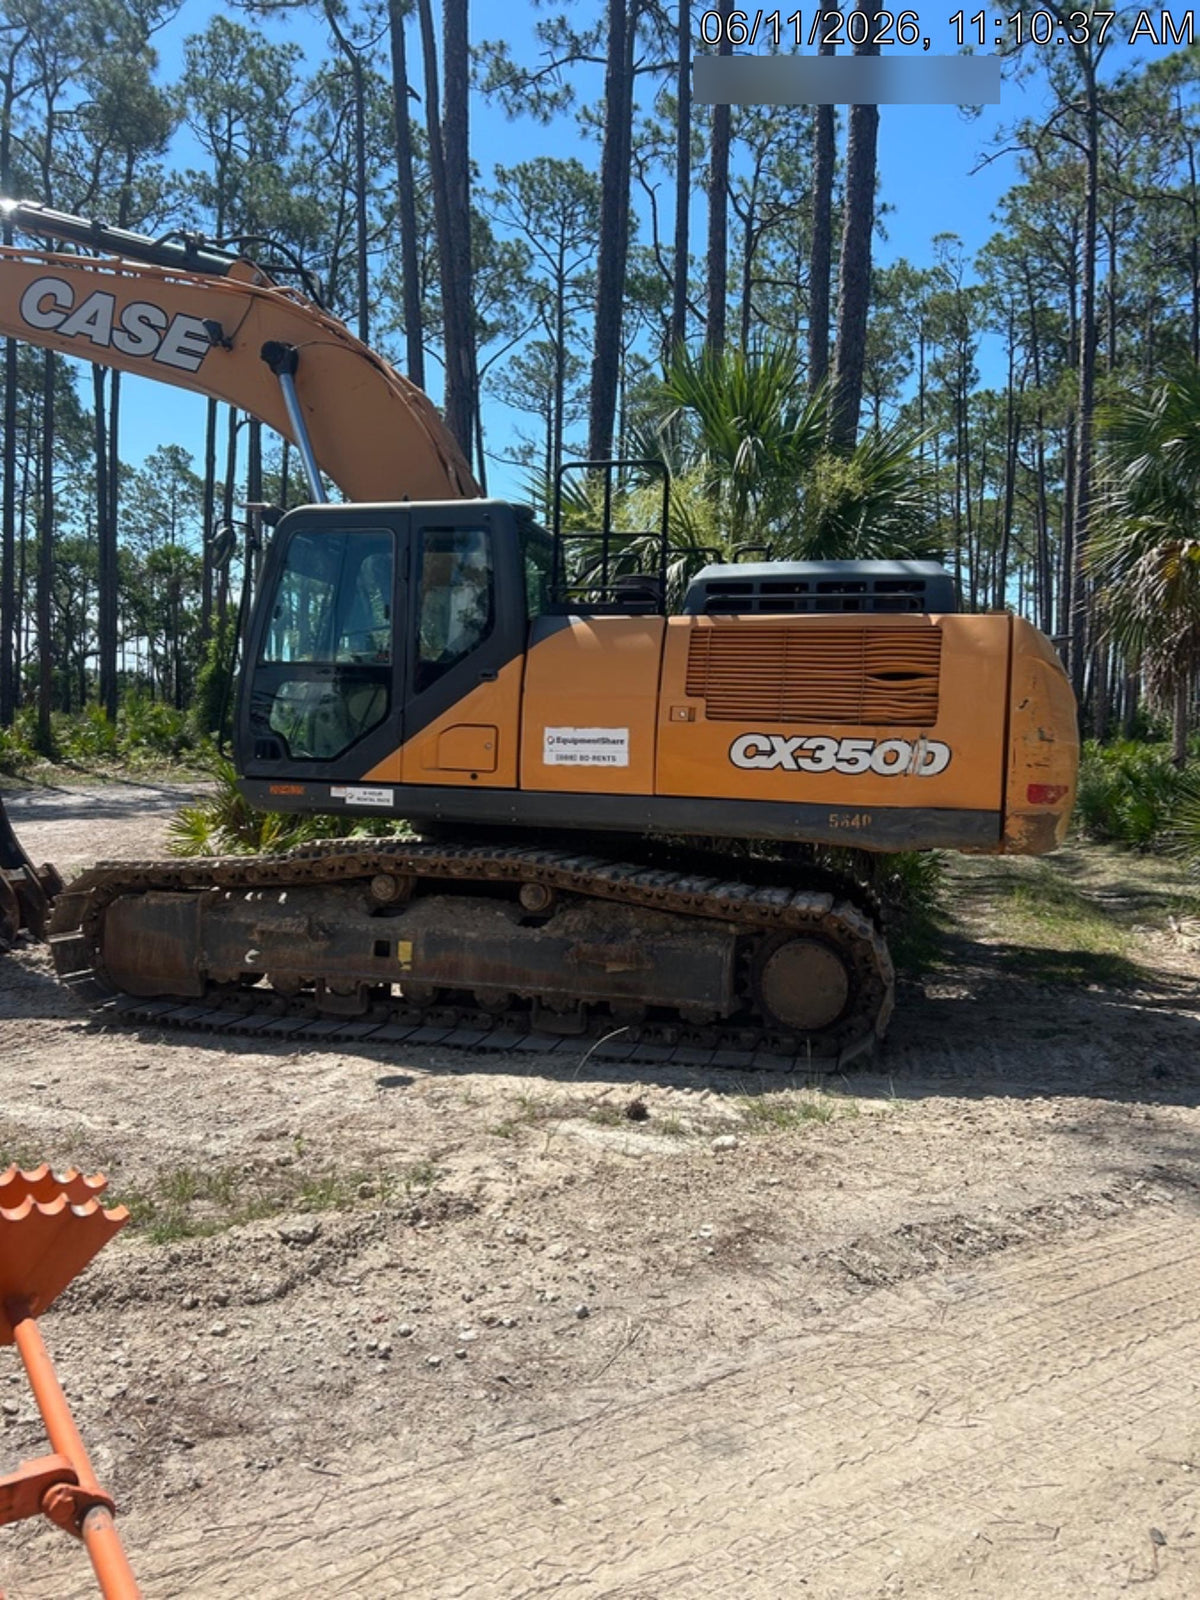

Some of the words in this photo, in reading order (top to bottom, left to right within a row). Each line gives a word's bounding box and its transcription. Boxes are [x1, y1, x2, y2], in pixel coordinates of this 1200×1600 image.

[20, 276, 211, 374] CASE
[556, 736, 625, 746] EquipmentShare
[728, 732, 952, 777] CX350D
